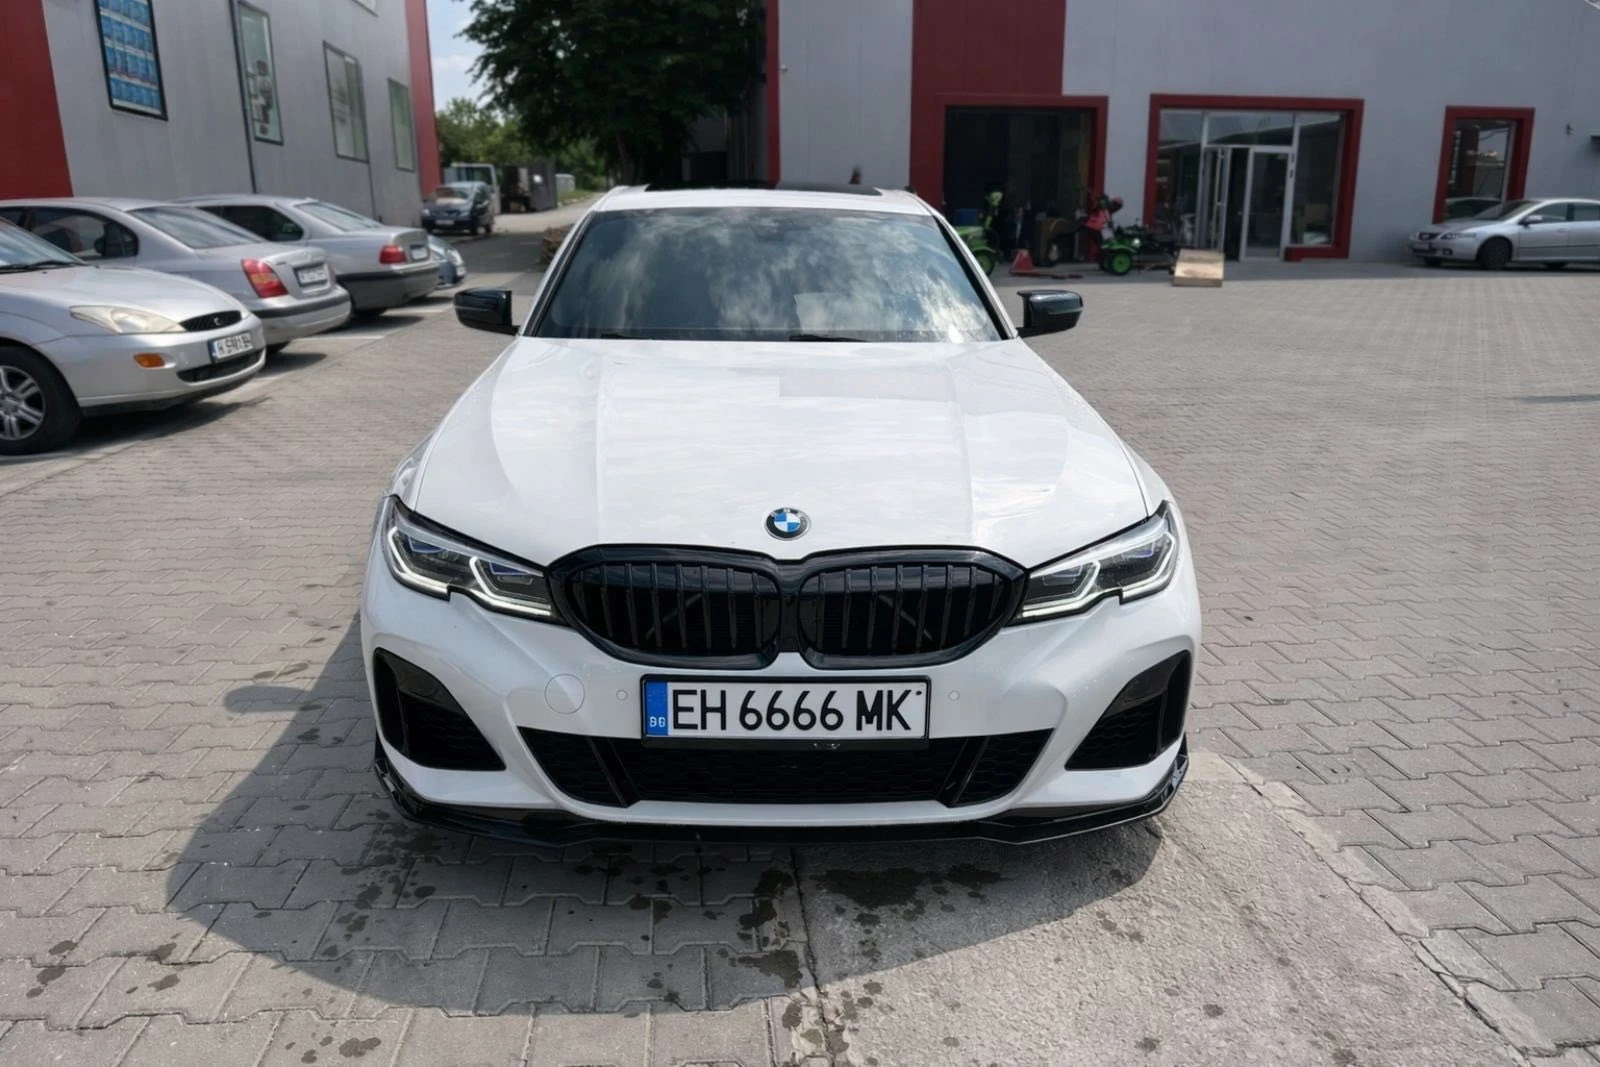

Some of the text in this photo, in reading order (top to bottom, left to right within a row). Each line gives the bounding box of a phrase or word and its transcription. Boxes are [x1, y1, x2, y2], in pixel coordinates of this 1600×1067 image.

[672, 689, 912, 732] EH 6666 MK
